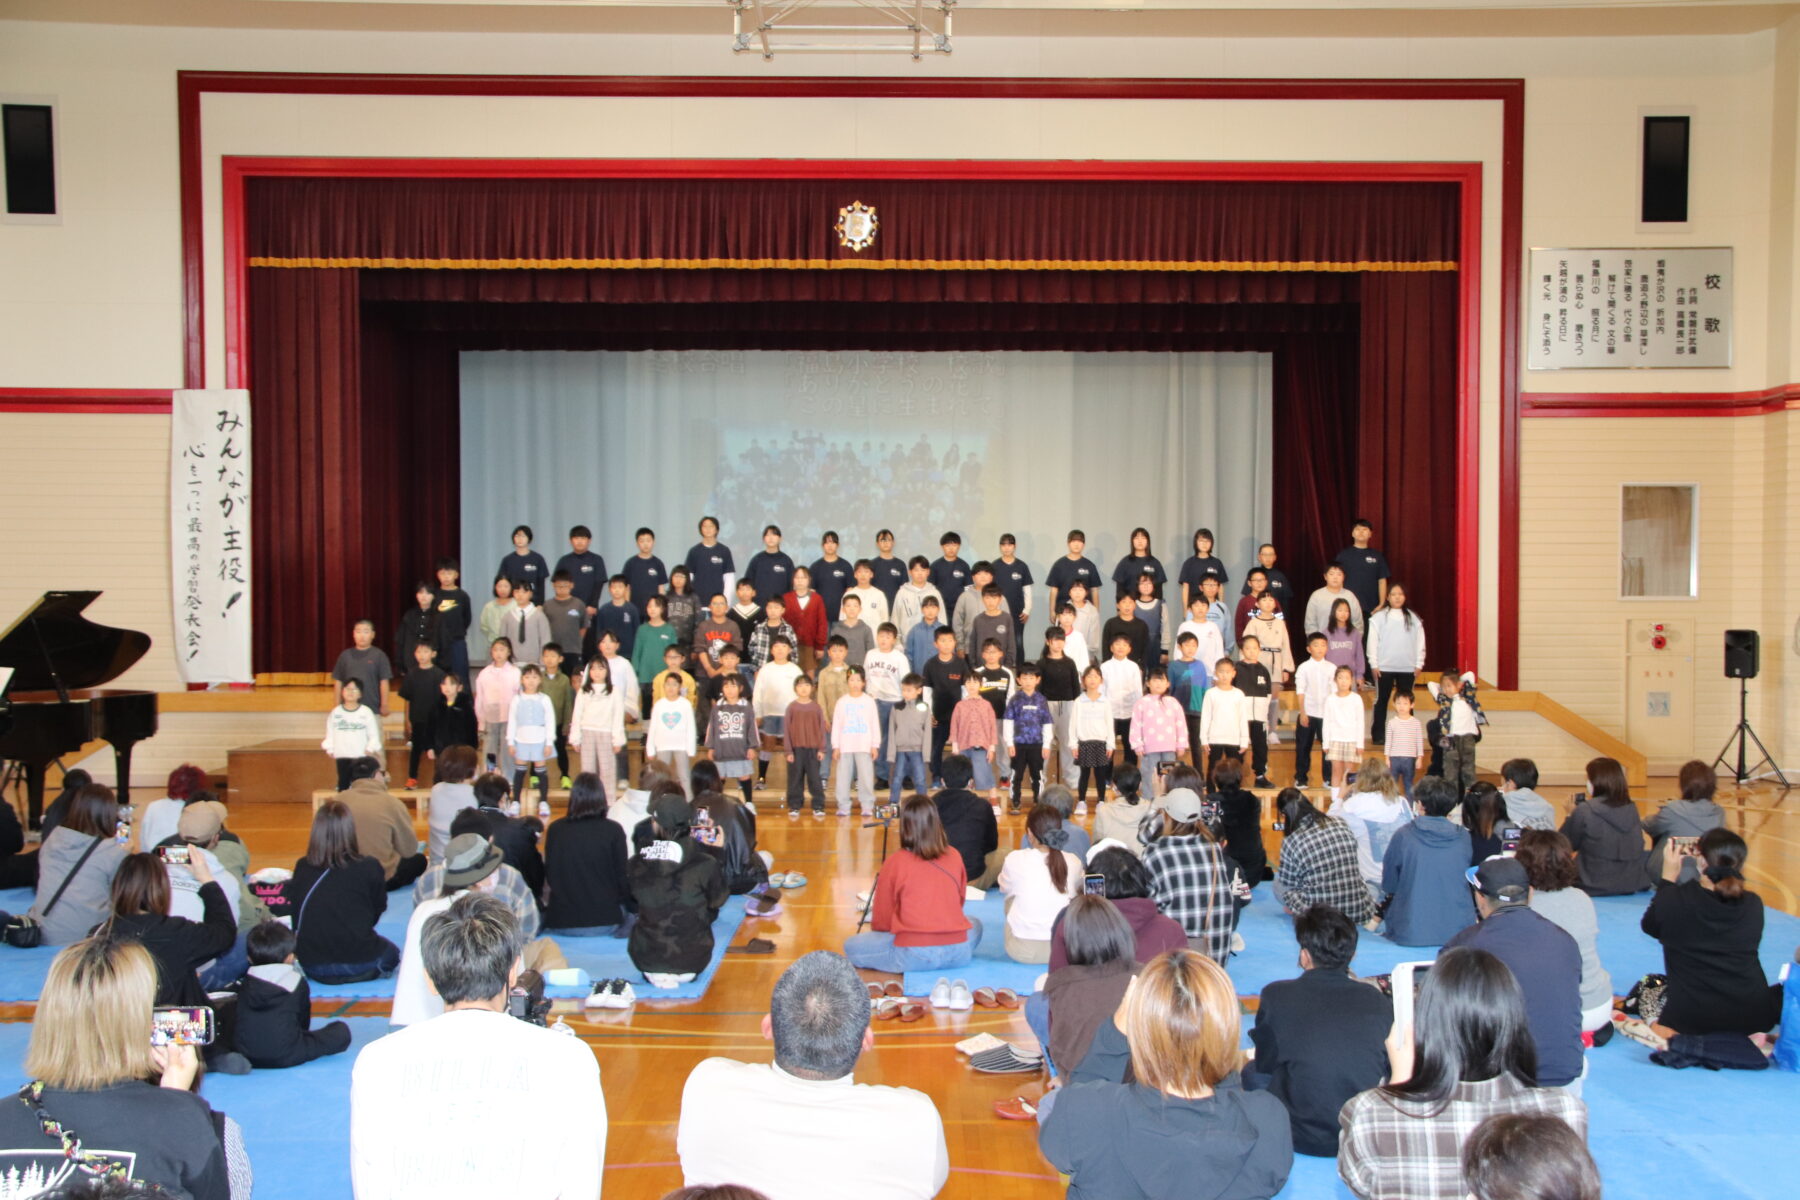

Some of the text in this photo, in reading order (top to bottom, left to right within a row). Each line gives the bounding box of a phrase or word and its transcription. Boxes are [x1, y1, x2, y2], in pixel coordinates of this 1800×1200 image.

[1704, 274, 1721, 333] 校歌
[216, 410, 247, 618] みんなが主役！
[718, 711, 744, 732] 39
